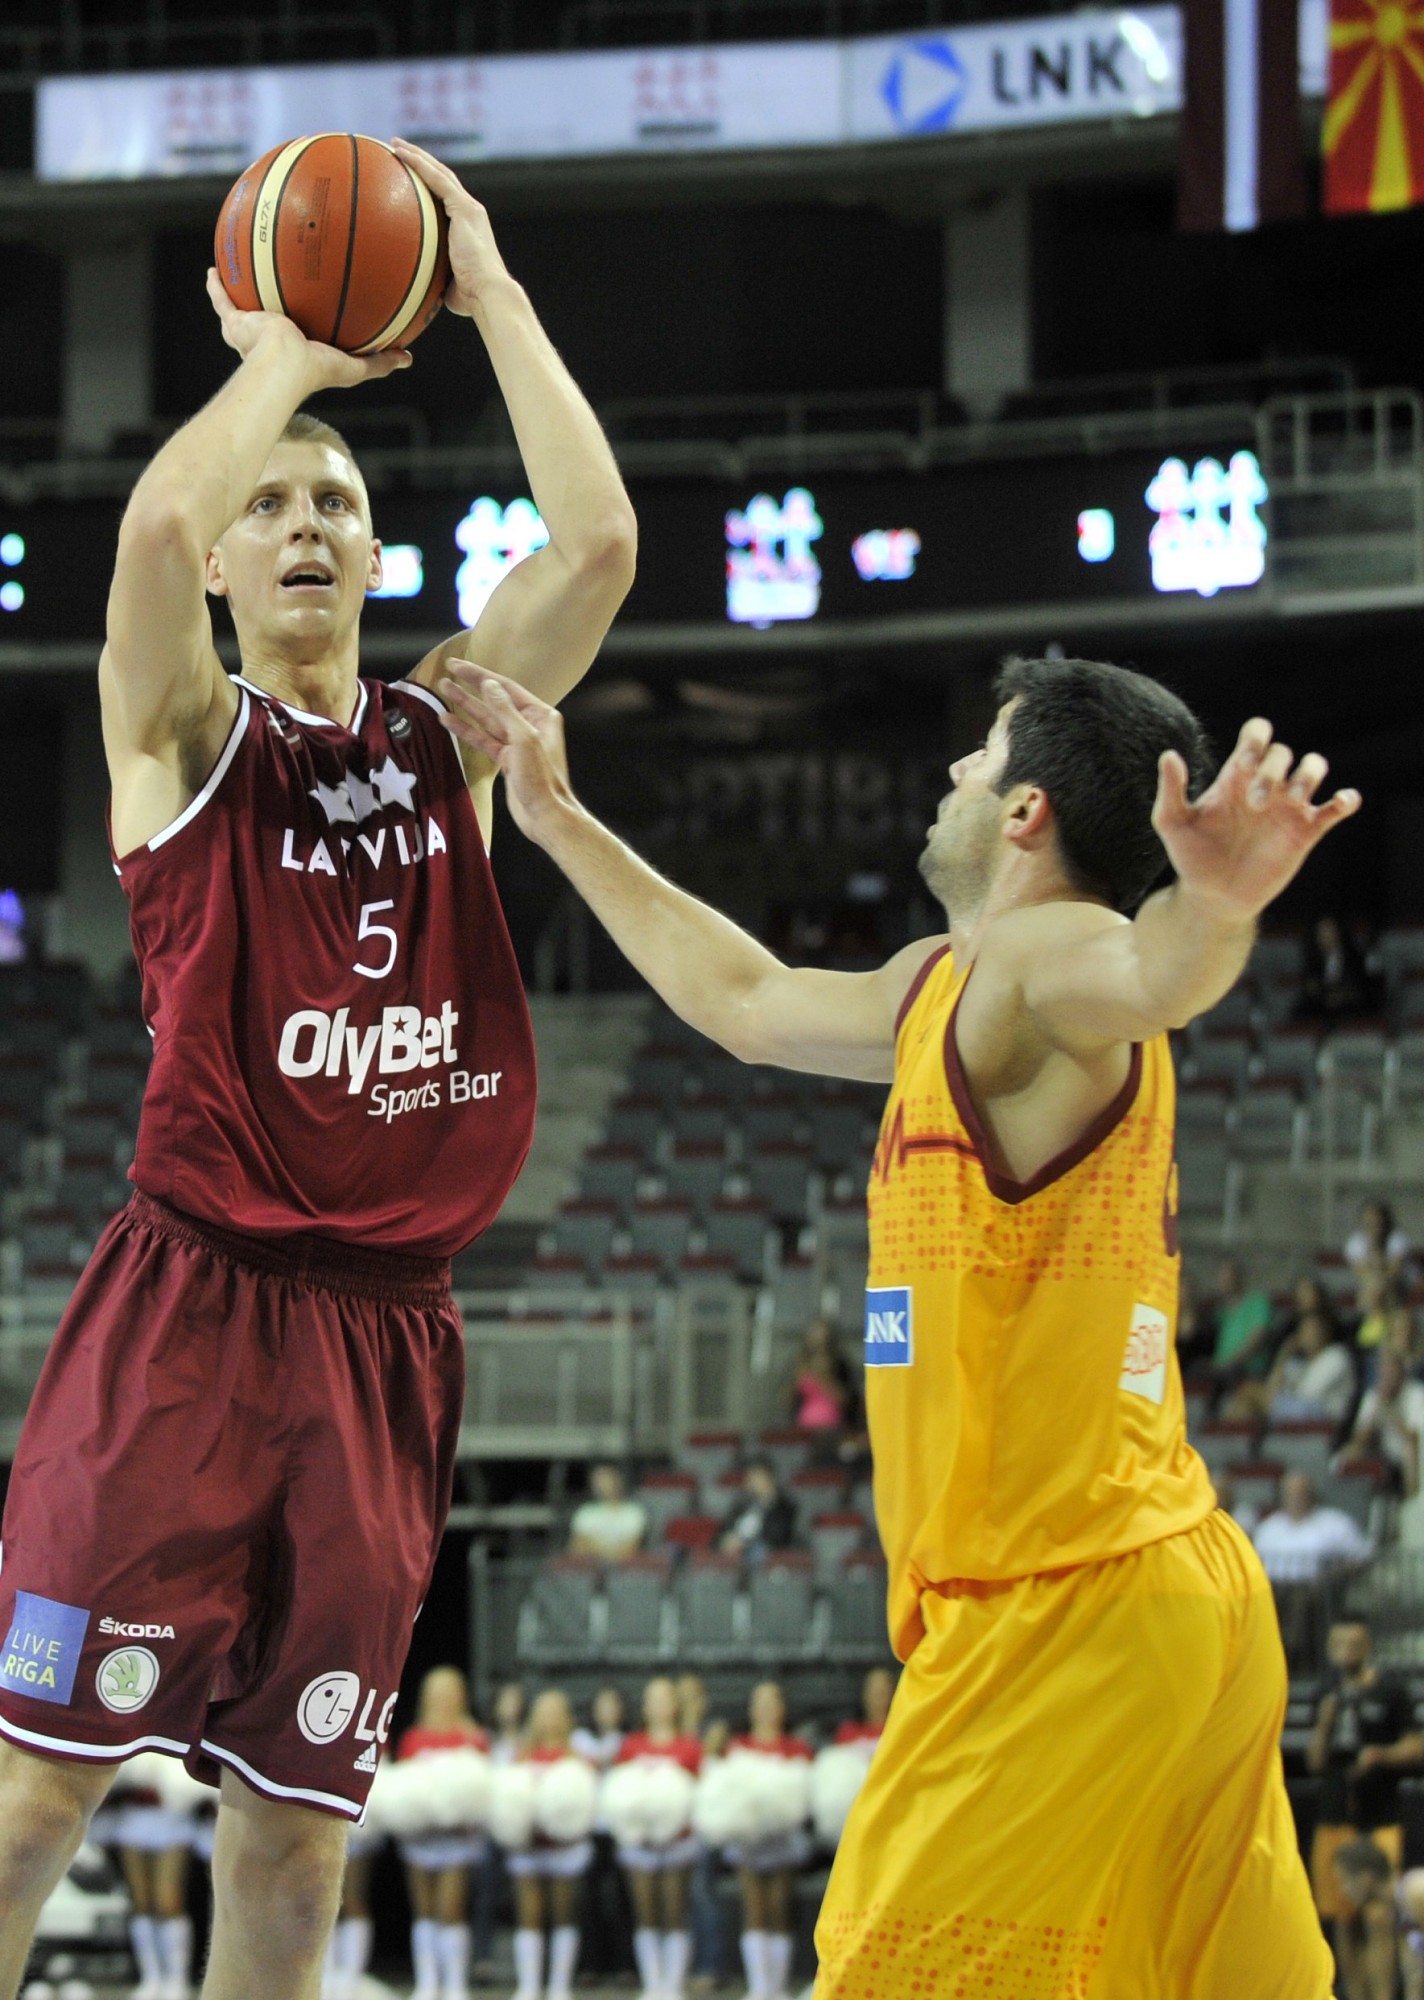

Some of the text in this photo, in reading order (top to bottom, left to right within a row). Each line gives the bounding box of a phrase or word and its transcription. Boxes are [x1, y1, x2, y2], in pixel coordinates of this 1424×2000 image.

[992, 35, 1124, 104] LNK
[259, 199, 271, 243] GL7X
[353, 899, 398, 979] 5
[277, 1000, 459, 1095] OlyBet
[367, 1070, 502, 1124] Sports Bar
[11, 1629, 62, 1662] LIVE
[98, 1616, 176, 1640] ŠKODA
